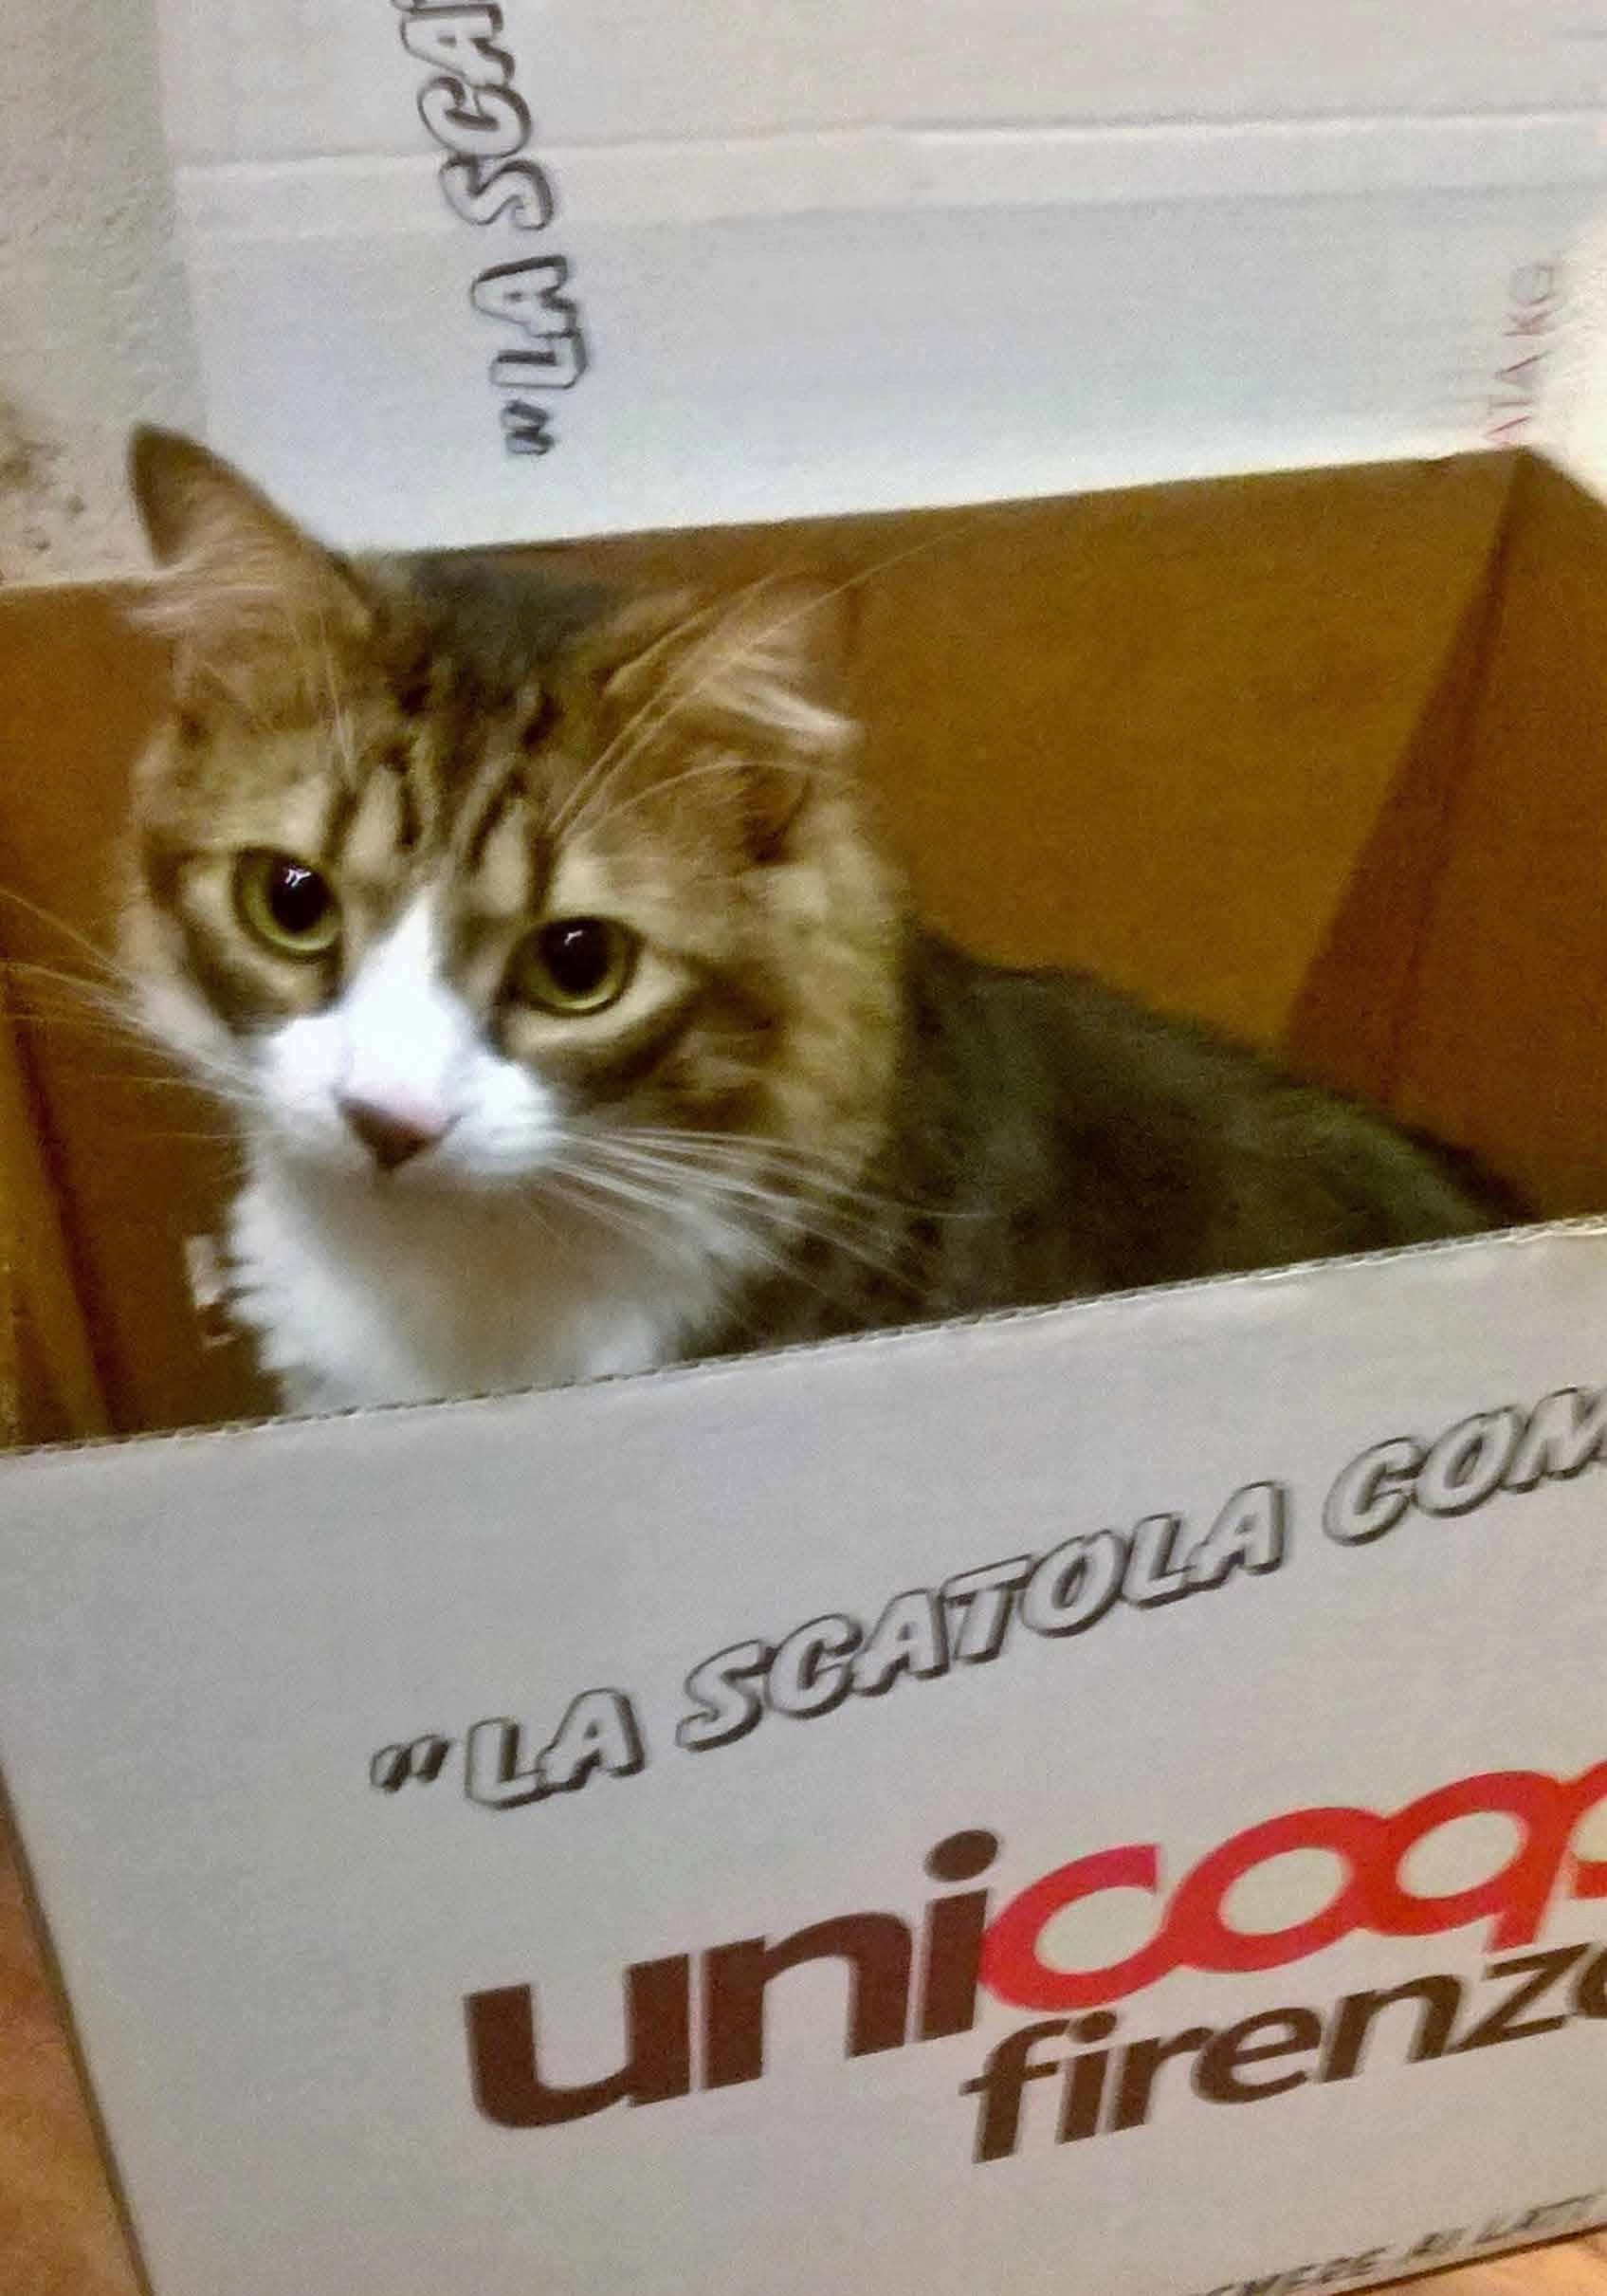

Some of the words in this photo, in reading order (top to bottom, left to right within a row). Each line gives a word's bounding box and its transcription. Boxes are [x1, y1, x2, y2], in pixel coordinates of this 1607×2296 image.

[390, 0, 555, 231] SCA
[370, 1687, 648, 1810] "LA
[675, 1480, 1290, 1752] SCATOLA
[958, 1940, 1607, 2165] firenz
